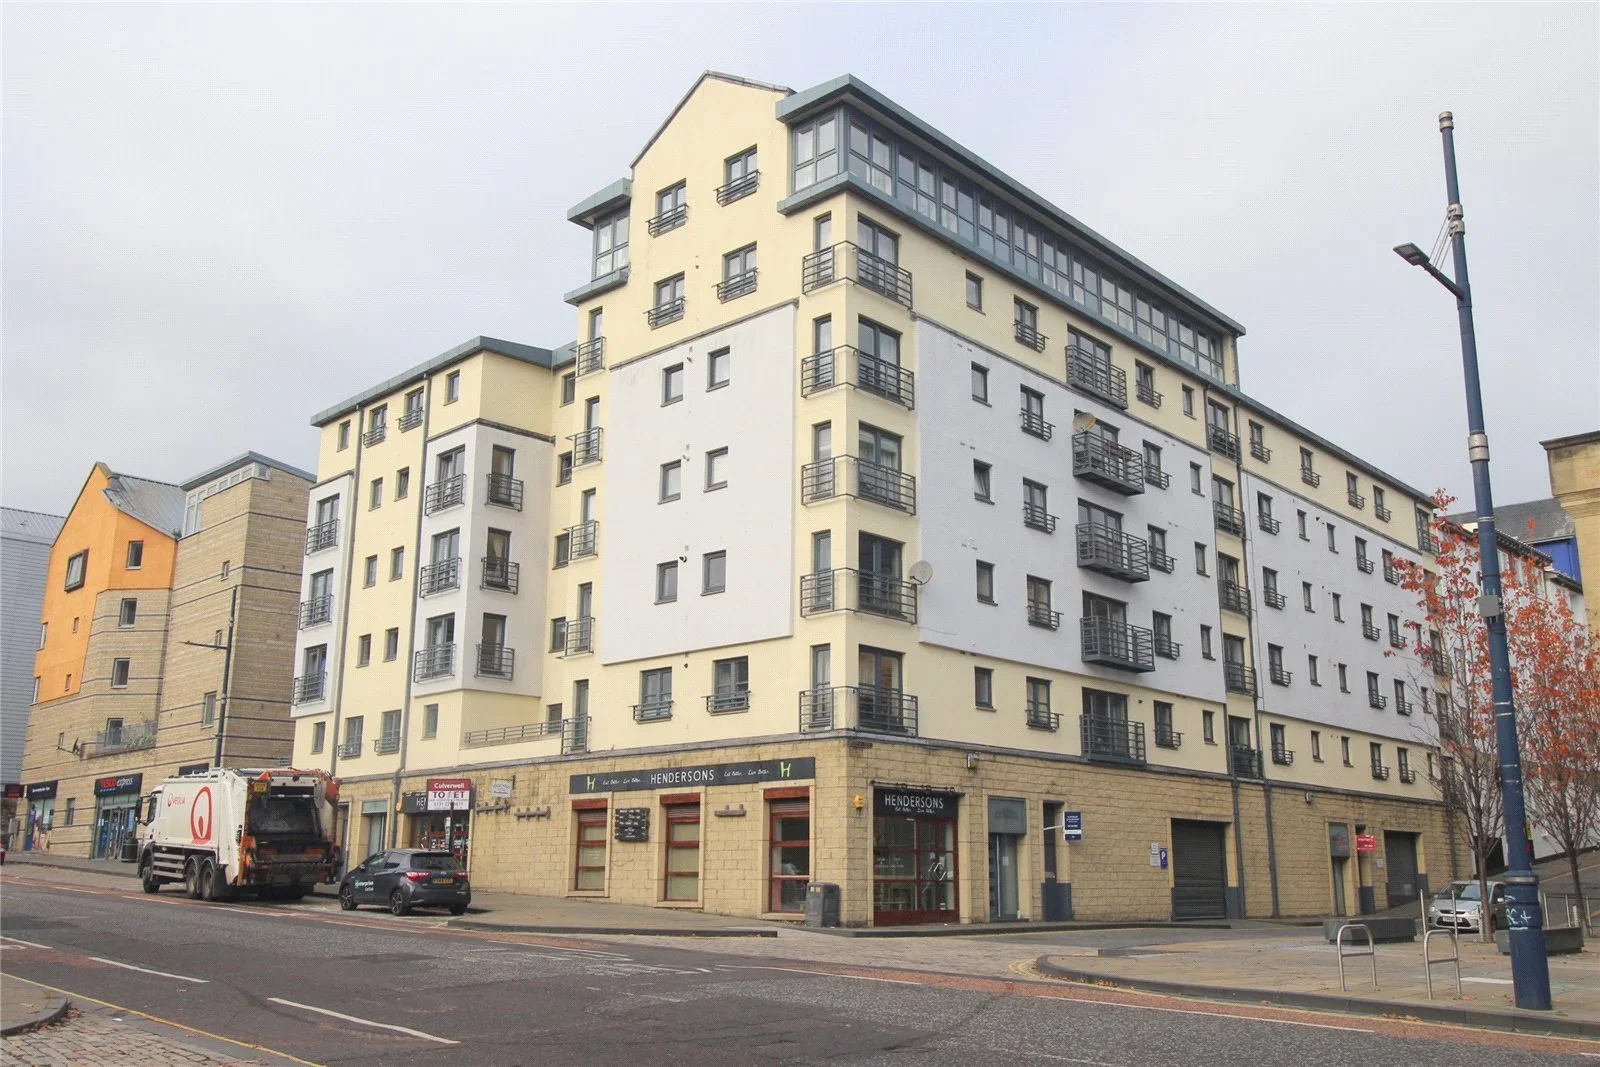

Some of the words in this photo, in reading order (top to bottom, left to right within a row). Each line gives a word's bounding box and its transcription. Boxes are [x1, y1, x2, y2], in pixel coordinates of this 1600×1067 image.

[650, 769, 715, 784] HENDERSONS
[781, 761, 791, 778] H
[586, 775, 596, 790] H
[432, 791, 446, 799] TO
[884, 794, 944, 809] HENDERSONS
